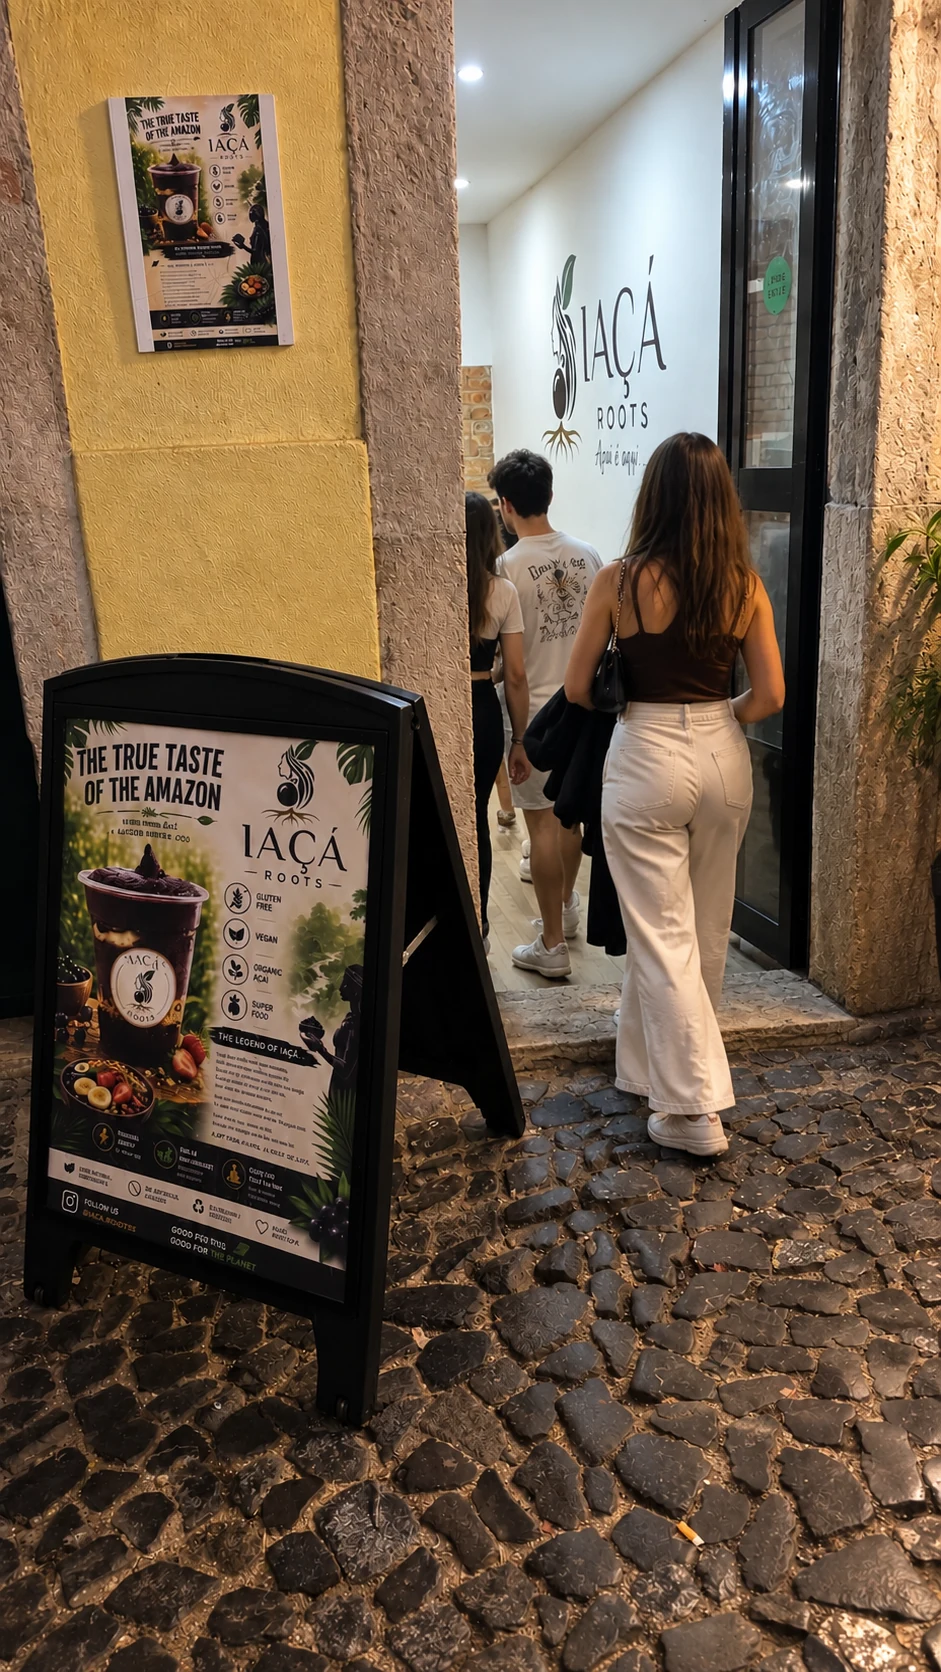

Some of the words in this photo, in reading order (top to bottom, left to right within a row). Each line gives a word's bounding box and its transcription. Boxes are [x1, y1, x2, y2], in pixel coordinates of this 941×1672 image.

[156, 113, 175, 128] TRUE
[175, 112, 199, 123] TASTE
[145, 130, 154, 141] OF
[171, 124, 201, 137] AMAZON
[580, 254, 667, 399] IAÇÁ
[597, 402, 649, 430] ROOTS
[77, 746, 108, 776] THE
[112, 743, 160, 771] TRUE
[165, 743, 225, 778] TASTE
[84, 779, 104, 806] OF
[109, 776, 140, 802] THE
[144, 776, 222, 811] AMAZON
[241, 823, 348, 874] IAÇÁ
[264, 870, 322, 889] ROOTS
[256, 892, 282, 904] GLUTEN
[256, 902, 273, 912] FREE
[255, 932, 278, 944] VEGAN
[253, 963, 283, 977] ORGANIC
[251, 1000, 274, 1012] SUPER
[218, 1032, 233, 1043] THE
[235, 1036, 266, 1050] LEGEND
[267, 1044, 279, 1053] OF
[110, 1206, 119, 1216] US
[171, 1226, 193, 1239] GOOD
[170, 1236, 192, 1249] GOOD
[193, 1244, 209, 1255] FOR
[226, 1254, 257, 1272] PLANET
